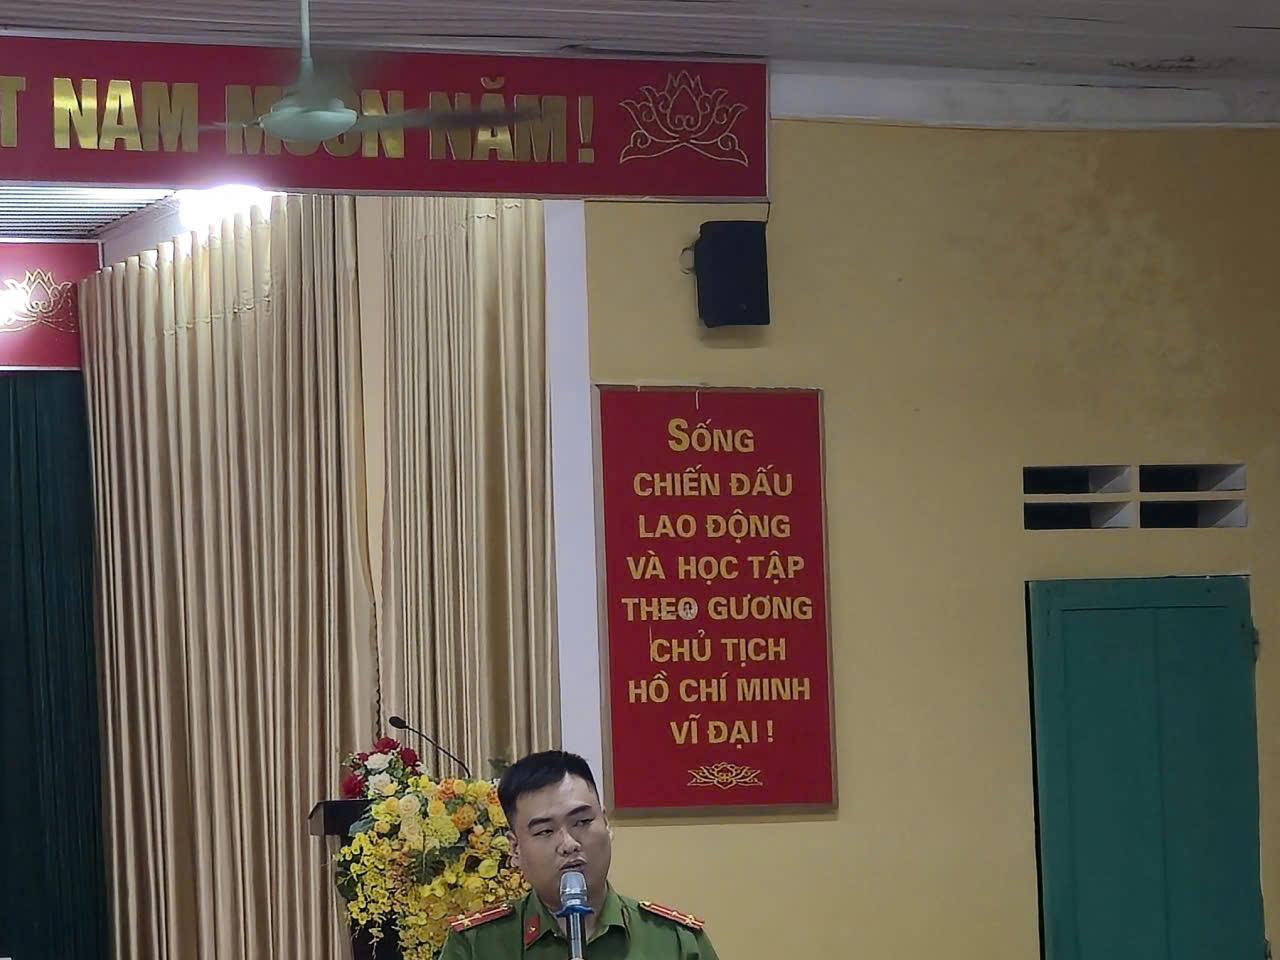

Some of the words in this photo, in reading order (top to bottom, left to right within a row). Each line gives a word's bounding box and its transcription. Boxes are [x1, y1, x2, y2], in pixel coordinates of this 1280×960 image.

[53, 77, 199, 153] NAM
[225, 83, 406, 158] MN
[668, 418, 754, 453] SỐNG
[633, 466, 721, 497] CHIẾN
[729, 465, 793, 497] ĐẤU
[639, 514, 697, 539] LAO
[706, 509, 791, 544] ĐỘNG
[626, 549, 665, 580] VÀ
[678, 556, 739, 585] HỌC
[748, 550, 805, 585] TẬP
[621, 597, 698, 621] THEO
[708, 594, 813, 620] GƯƠNG
[651, 629, 711, 663] CHỦ
[722, 637, 786, 667] TỊCH
[628, 670, 670, 703] HỒ
[680, 672, 727, 702] CHÍ
[737, 677, 810, 702] MINH
[670, 713, 701, 745] VĨ
[708, 719, 759, 749] ĐẠI
